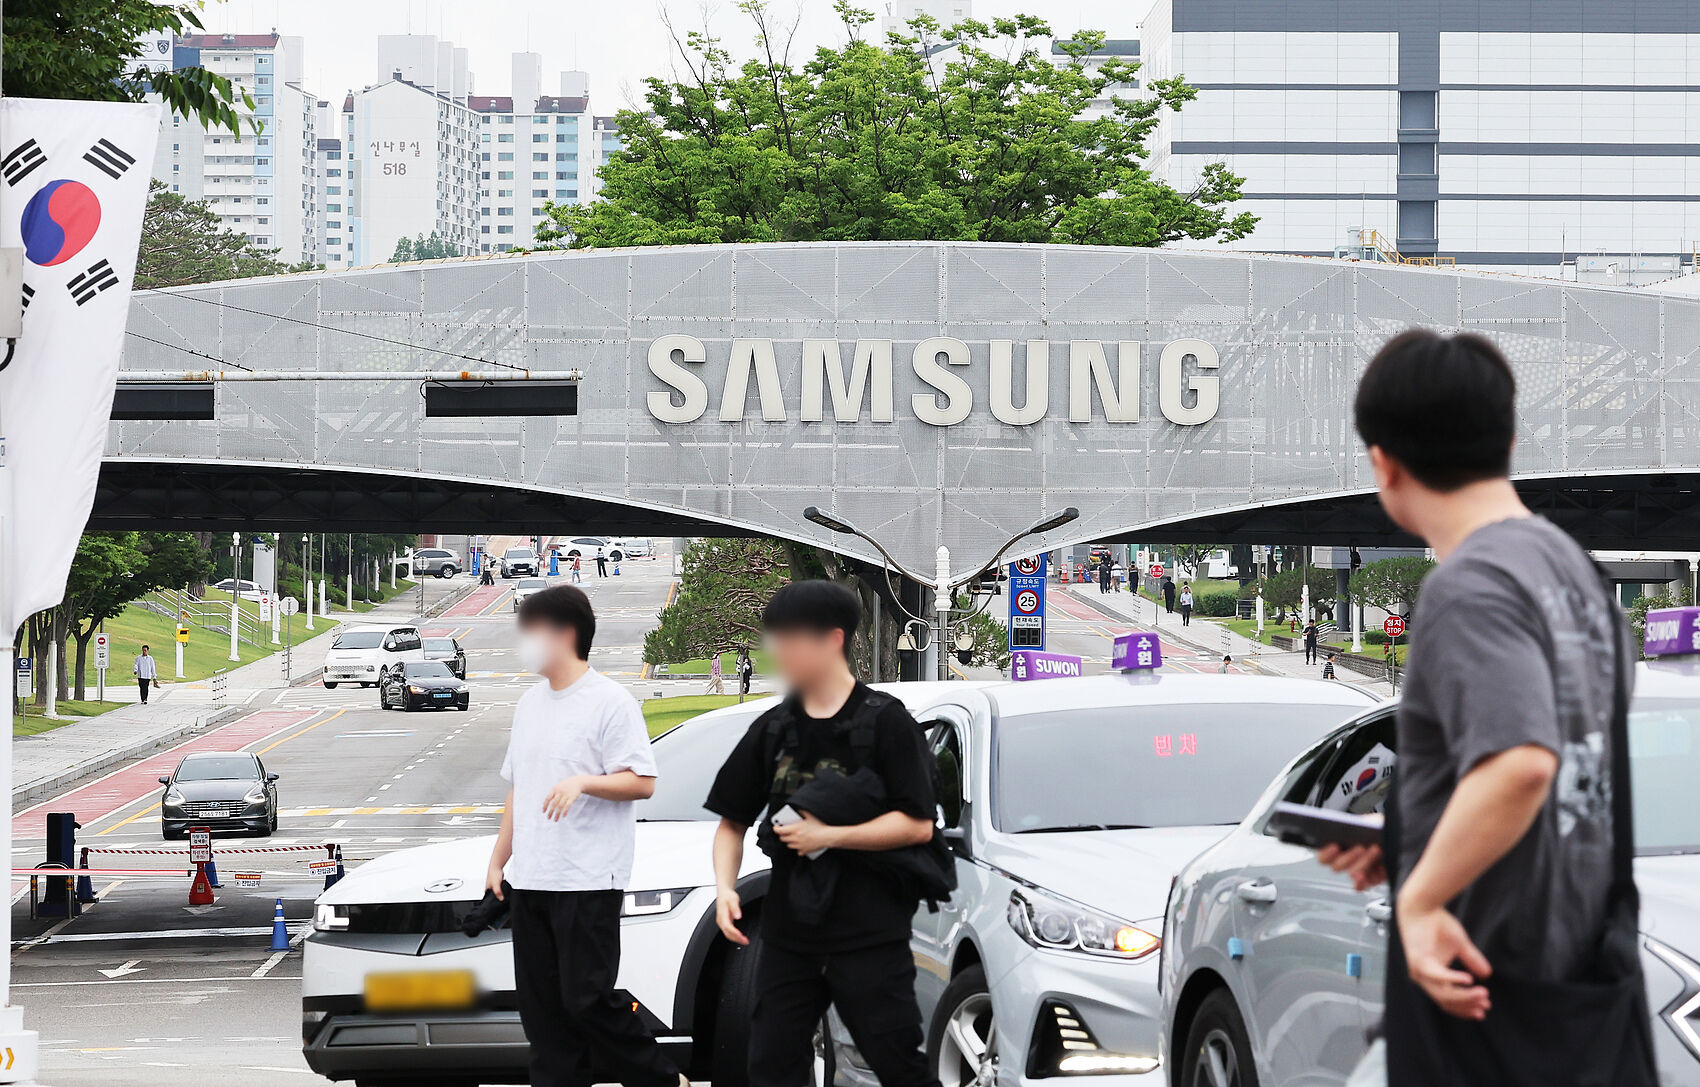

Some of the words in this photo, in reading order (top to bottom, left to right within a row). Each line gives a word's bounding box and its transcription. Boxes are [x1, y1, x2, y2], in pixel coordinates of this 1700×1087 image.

[370, 141, 421, 157] 신나무실
[383, 163, 406, 175] 518
[646, 334, 1220, 427] SAMSUNG
[1020, 596, 1035, 607] 25
[1386, 619, 1401, 627] 정지
[1137, 636, 1153, 666] 수원
[1015, 654, 1027, 678] 수원
[1035, 658, 1080, 676] SUWON
[317, 866, 336, 875] 진입금지
